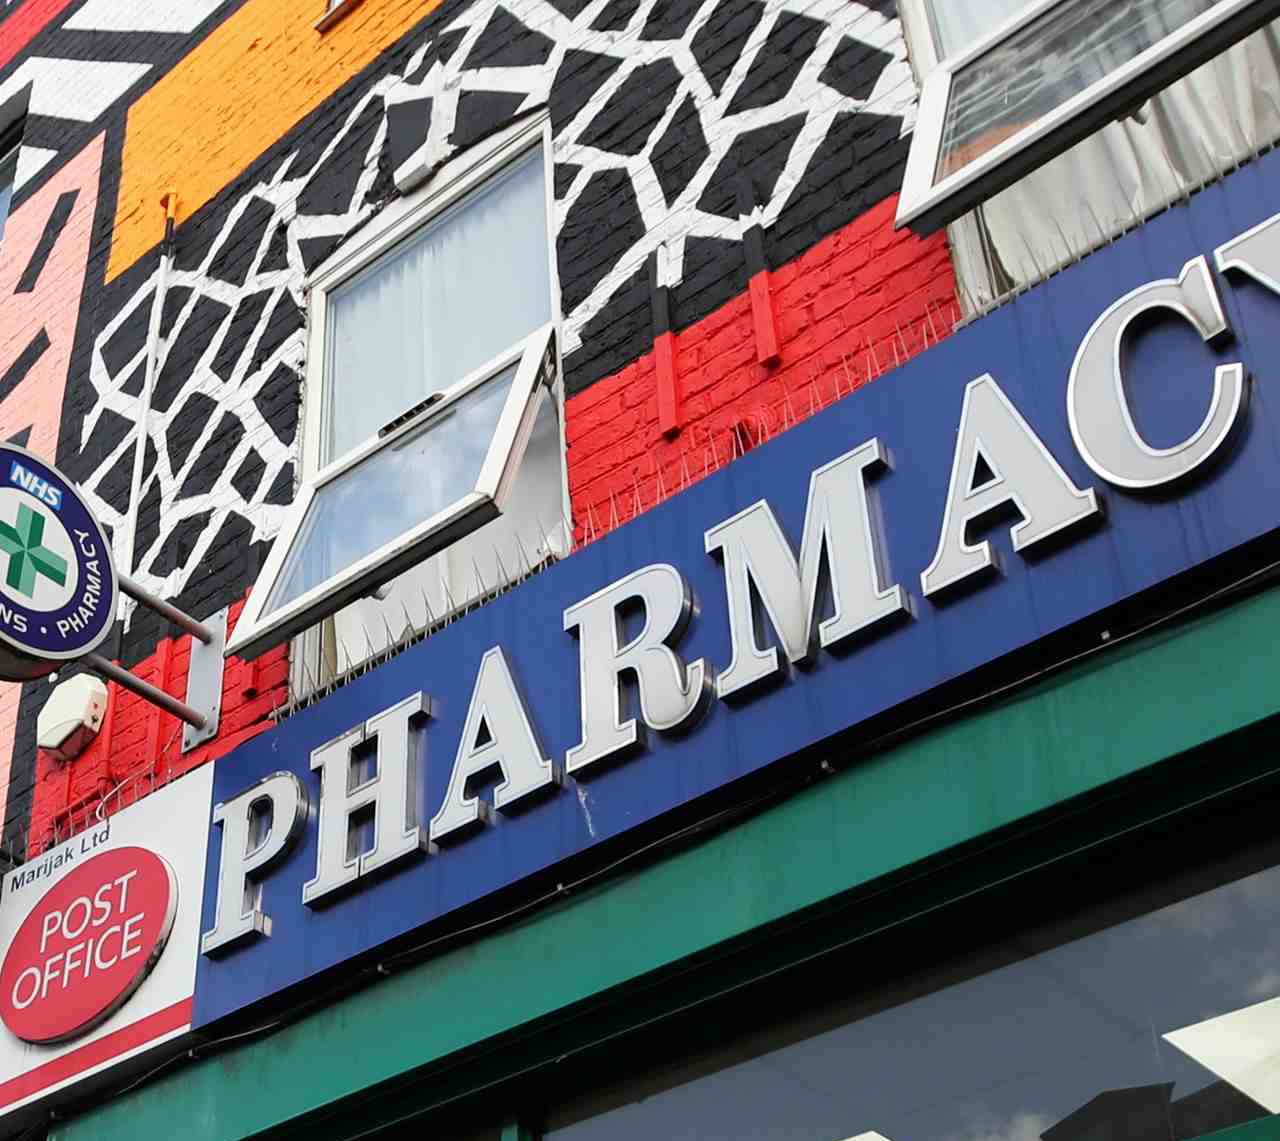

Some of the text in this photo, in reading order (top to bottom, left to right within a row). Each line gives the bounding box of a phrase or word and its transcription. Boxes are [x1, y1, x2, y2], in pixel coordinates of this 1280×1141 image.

[11, 463, 63, 509] NHS
[56, 528, 102, 639] PHARMACY
[9, 824, 111, 893] Marijak Ltd
[38, 869, 138, 954] POST
[12, 912, 146, 1010] OFFICE
